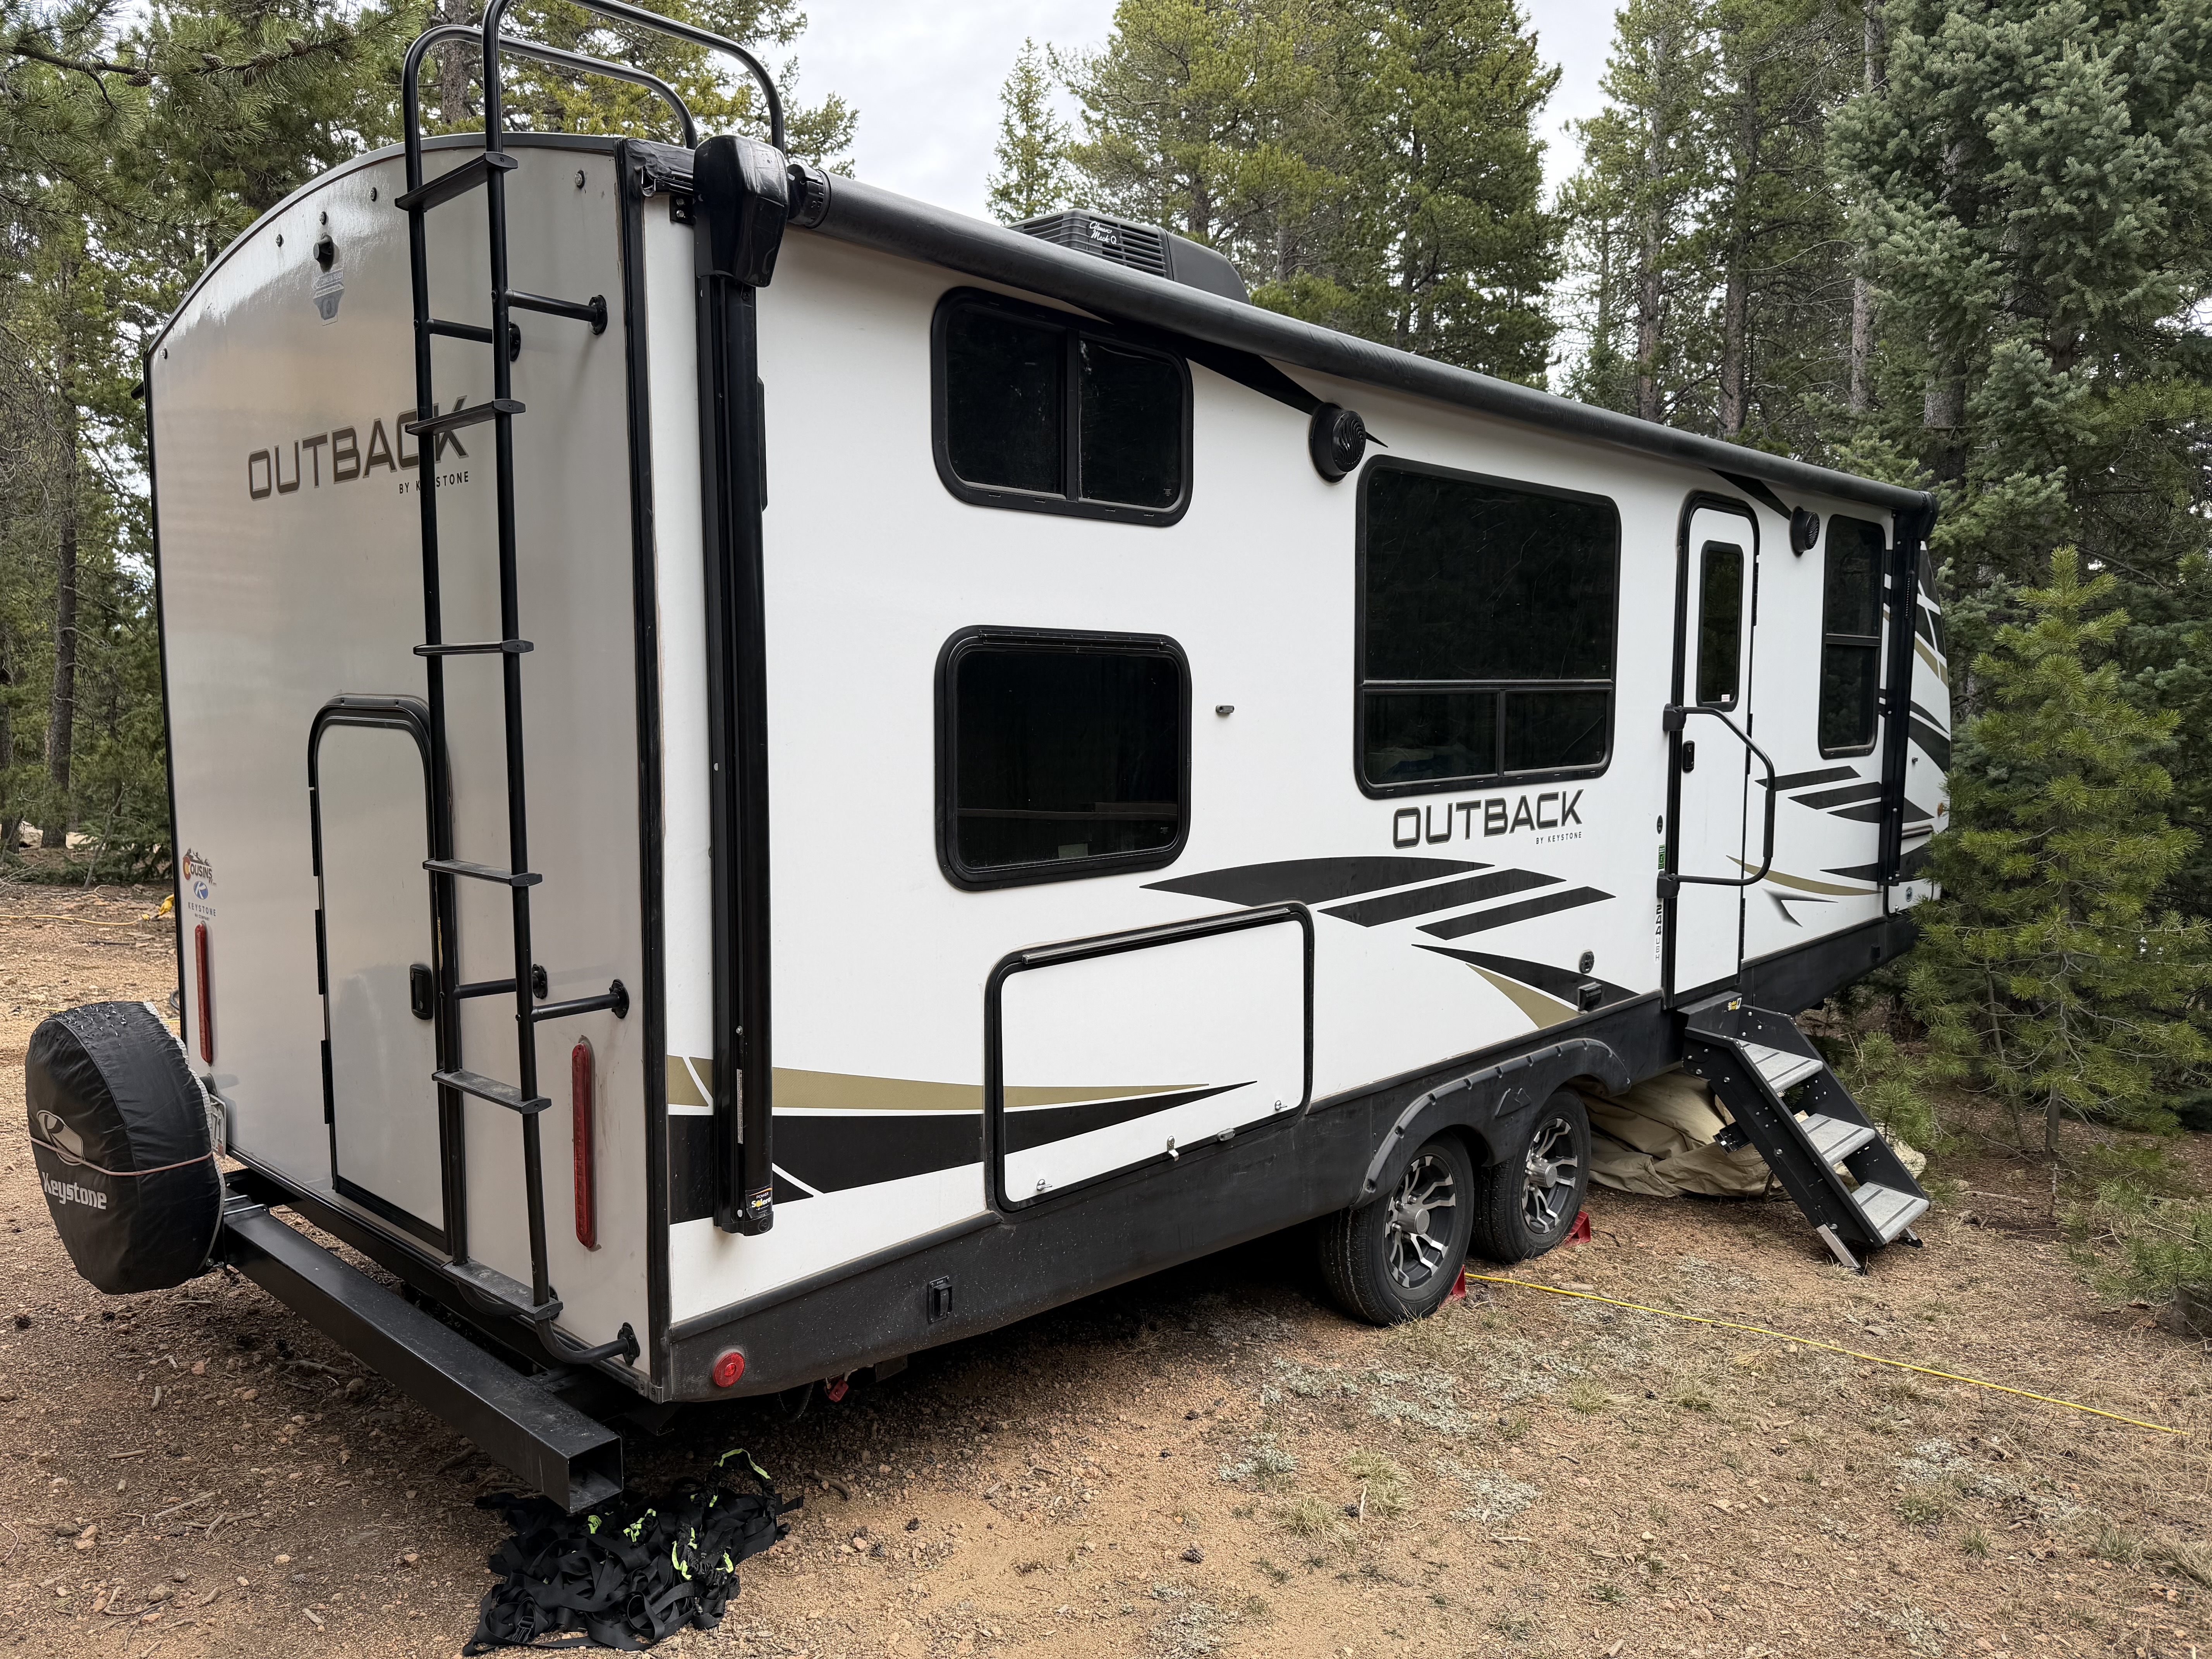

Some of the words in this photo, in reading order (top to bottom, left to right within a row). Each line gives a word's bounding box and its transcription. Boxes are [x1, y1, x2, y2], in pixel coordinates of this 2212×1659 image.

[1111, 235, 1117, 245] Q
[248, 395, 469, 501] OUTBACK
[399, 482, 409, 494] BY
[416, 471, 469, 491] KSTONE
[1393, 789, 1584, 849] OUTBACK
[1548, 831, 1582, 843] KEYSTONE
[183, 855, 213, 880] COUSINS
[188, 902, 216, 917] KEYSTONE
[42, 1171, 107, 1210] Keystone
[751, 1197, 771, 1208] Solera
